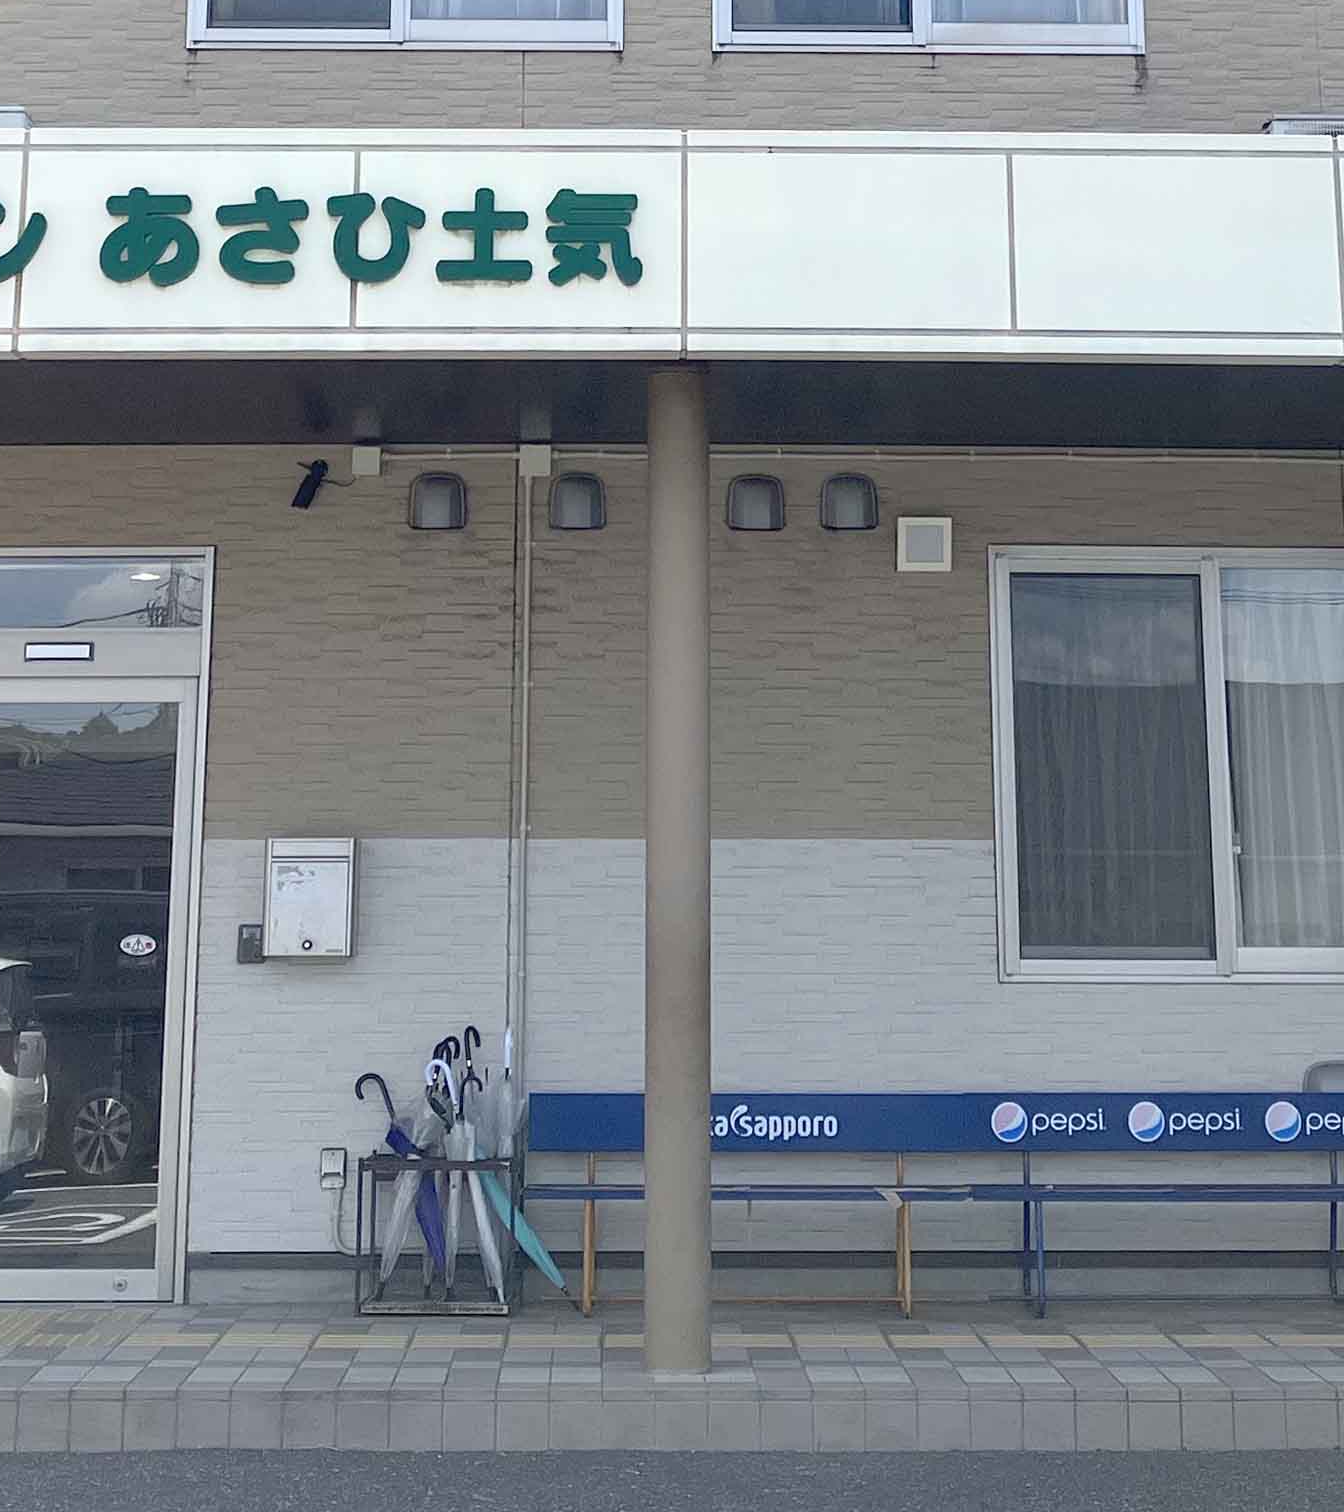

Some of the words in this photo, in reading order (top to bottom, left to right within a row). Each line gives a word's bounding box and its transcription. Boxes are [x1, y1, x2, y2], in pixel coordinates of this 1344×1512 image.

[100, 187, 643, 287] あさひ土気
[1032, 1108, 1104, 1136] pepsi
[1169, 1108, 1241, 1136] pepsi
